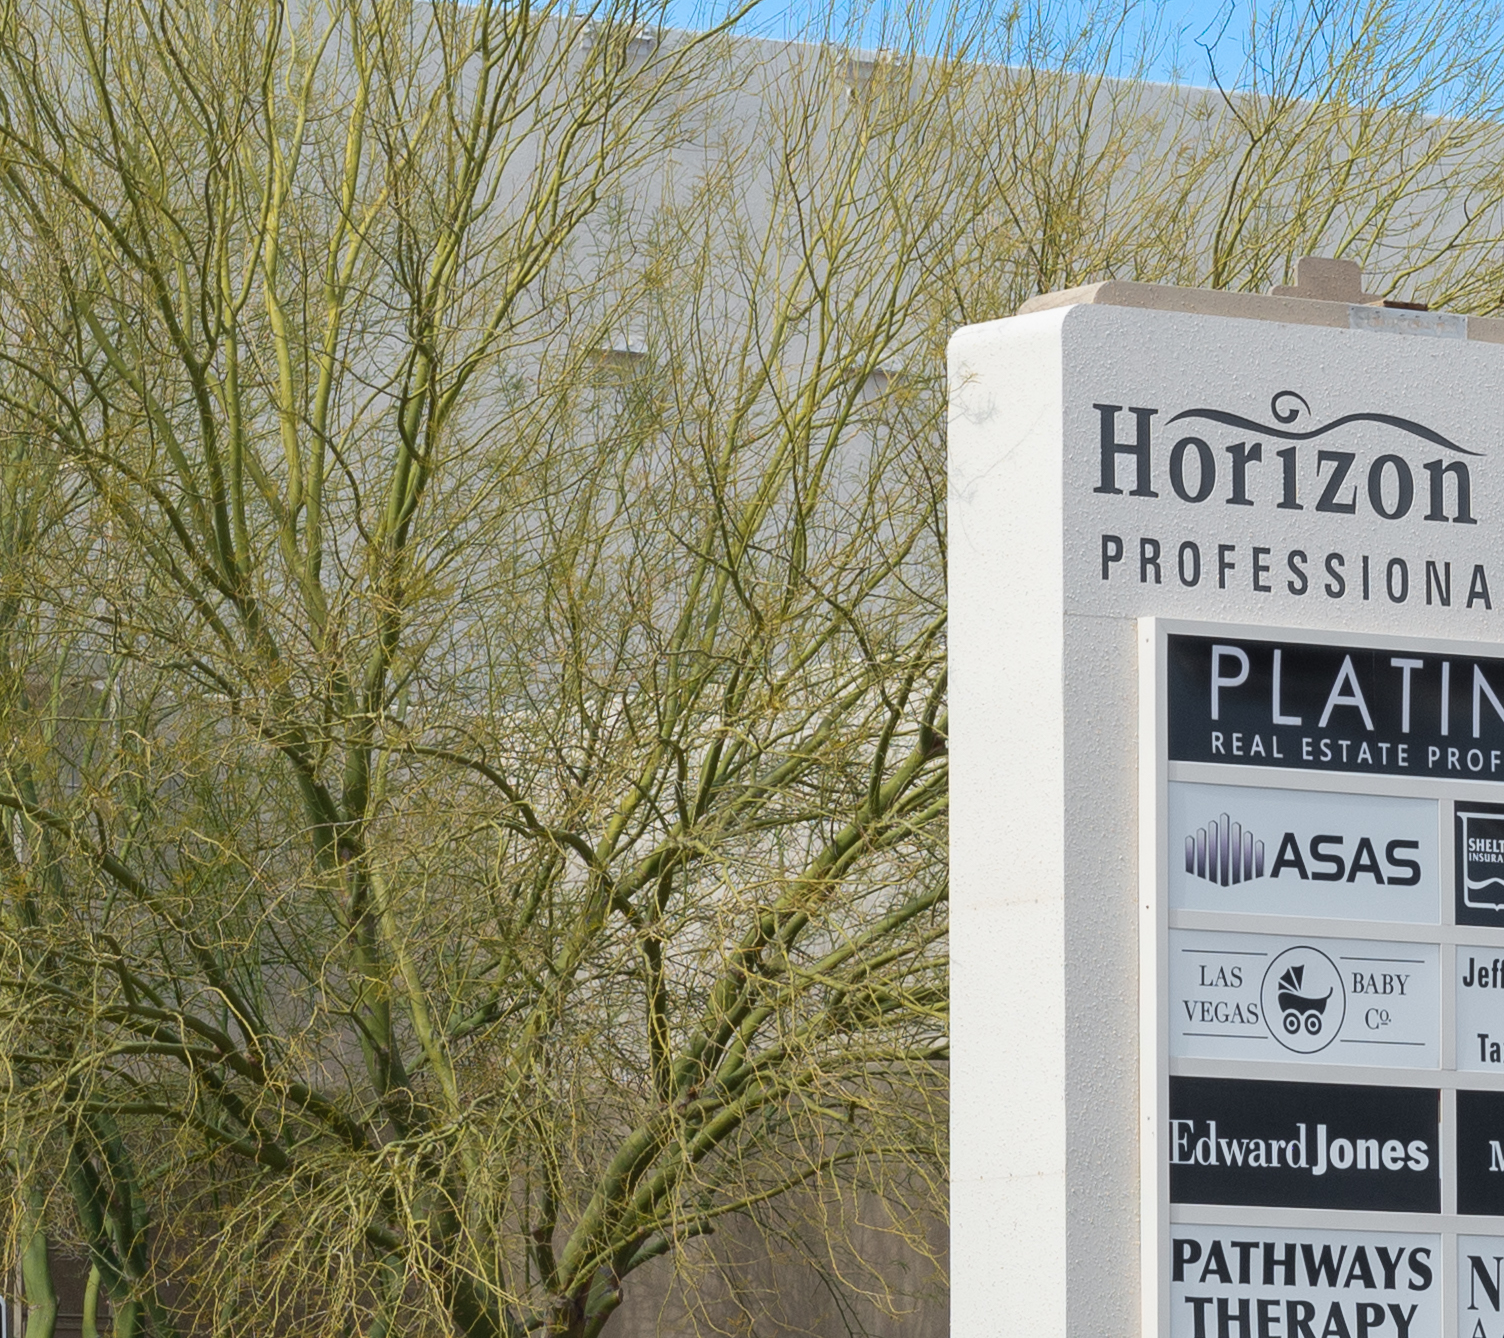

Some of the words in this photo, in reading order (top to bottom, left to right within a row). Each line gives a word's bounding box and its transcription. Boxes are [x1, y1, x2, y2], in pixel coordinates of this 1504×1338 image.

[1092, 402, 1478, 526] Horizon
[1212, 730, 1283, 759] REAL
[1302, 737, 1410, 769] ESTATE
[1270, 832, 1422, 888] ASAS
[1199, 965, 1243, 988] LAS
[1351, 972, 1411, 996] BABY
[1182, 1000, 1259, 1024] VEGAS
[1171, 1238, 1433, 1293] PATHWAYS
